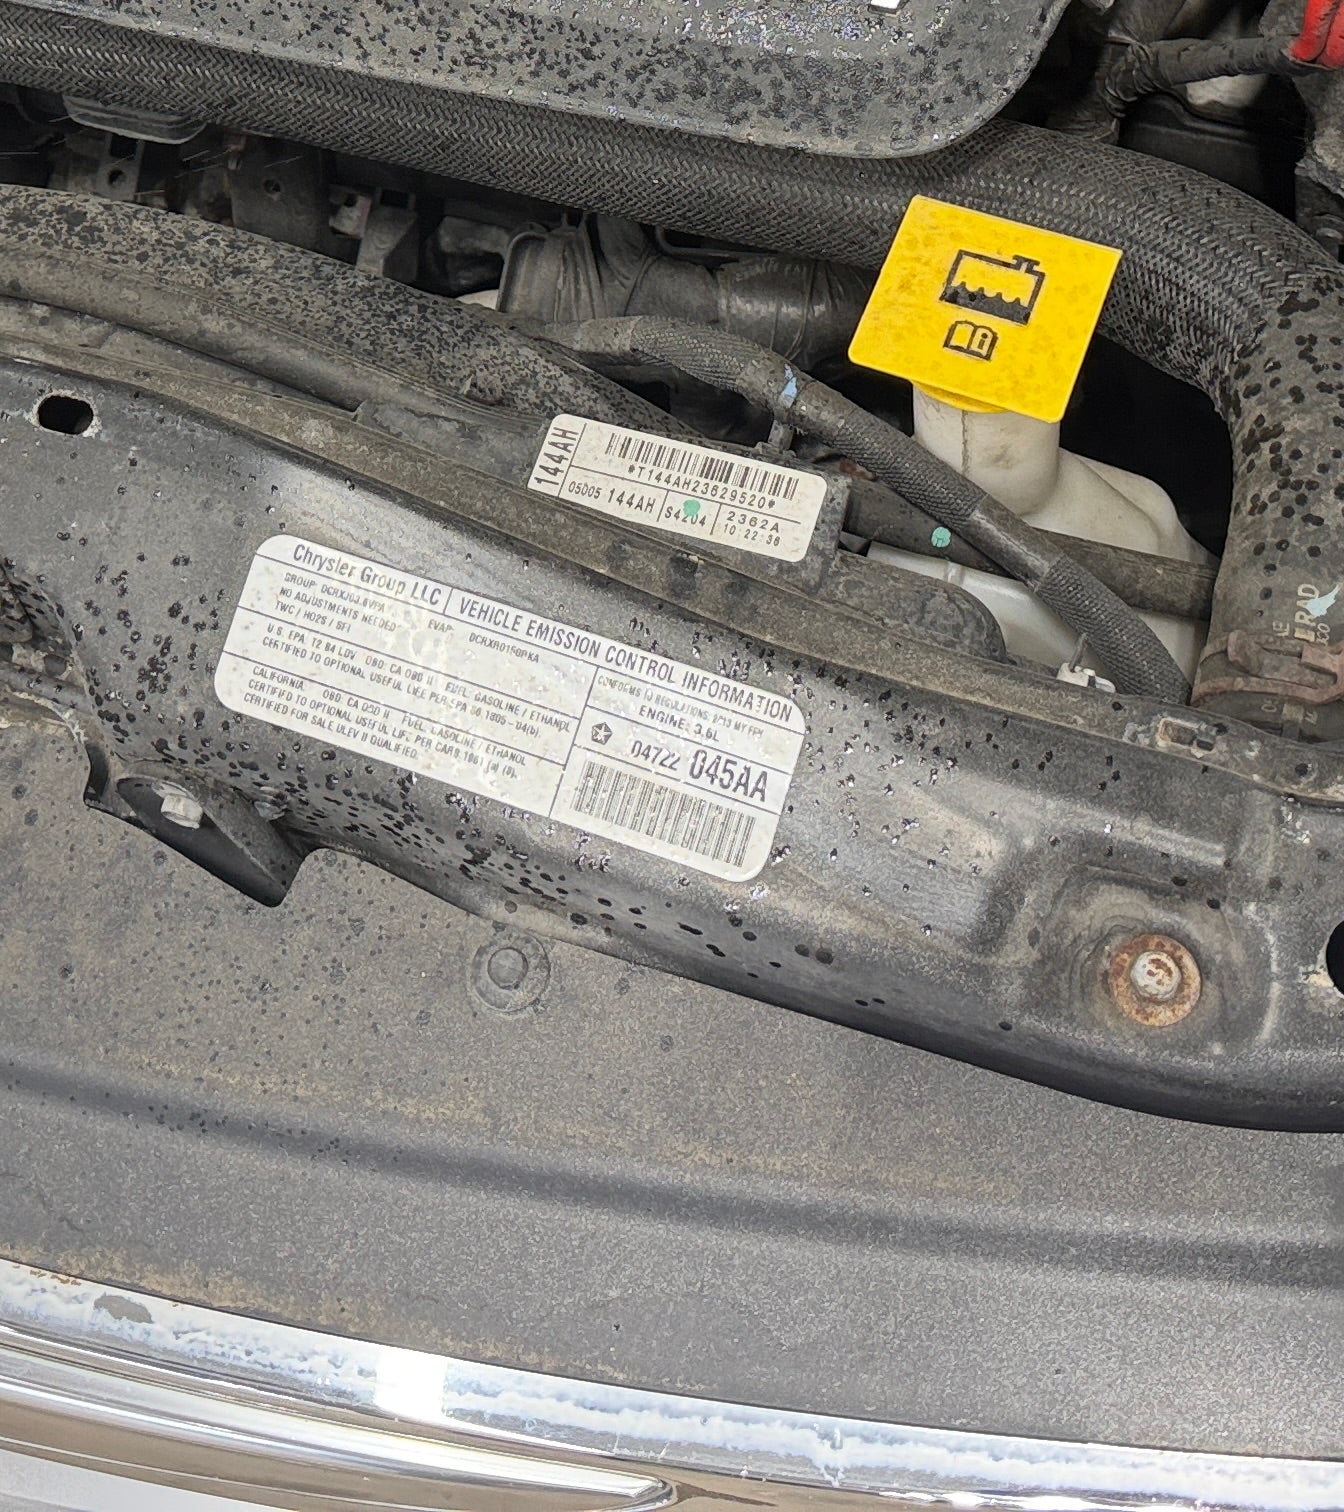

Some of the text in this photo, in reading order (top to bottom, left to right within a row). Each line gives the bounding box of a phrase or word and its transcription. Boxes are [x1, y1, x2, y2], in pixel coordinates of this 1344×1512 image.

[532, 426, 578, 489] 144AH
[566, 479, 656, 514] 05005 144AH
[273, 599, 295, 615] TWC
[334, 619, 352, 633] SFI
[278, 586, 293, 599] NO
[293, 591, 360, 621] ADJUSTMENTS
[290, 542, 795, 723] Chrysler Group LLC VEHICLE EMISSION CONTROL INFORMATION
[261, 635, 308, 659] CERTIFIED
[308, 651, 322, 664] TO
[322, 655, 368, 680] OPTIONAL
[368, 671, 405, 692] USEFUL
[310, 637, 323, 649] T2
[388, 663, 403, 676] CA
[473, 691, 521, 715] GASOLINE
[528, 709, 572, 733] ETHANOL
[242, 691, 289, 715] CERTIFIED
[289, 707, 309, 722] FOR
[309, 714, 335, 731] SALE
[334, 723, 359, 740] ULEV
[247, 677, 294, 702] CERTIFIED
[294, 694, 308, 707] TO
[308, 698, 354, 723] OPTIONAL
[354, 714, 390, 735] USEFUL
[413, 735, 433, 750] PER
[345, 696, 360, 710] CA
[483, 743, 528, 767] ETHANOL
[692, 722, 723, 743] 3.6L
[629, 738, 776, 803] 04722 045AA
